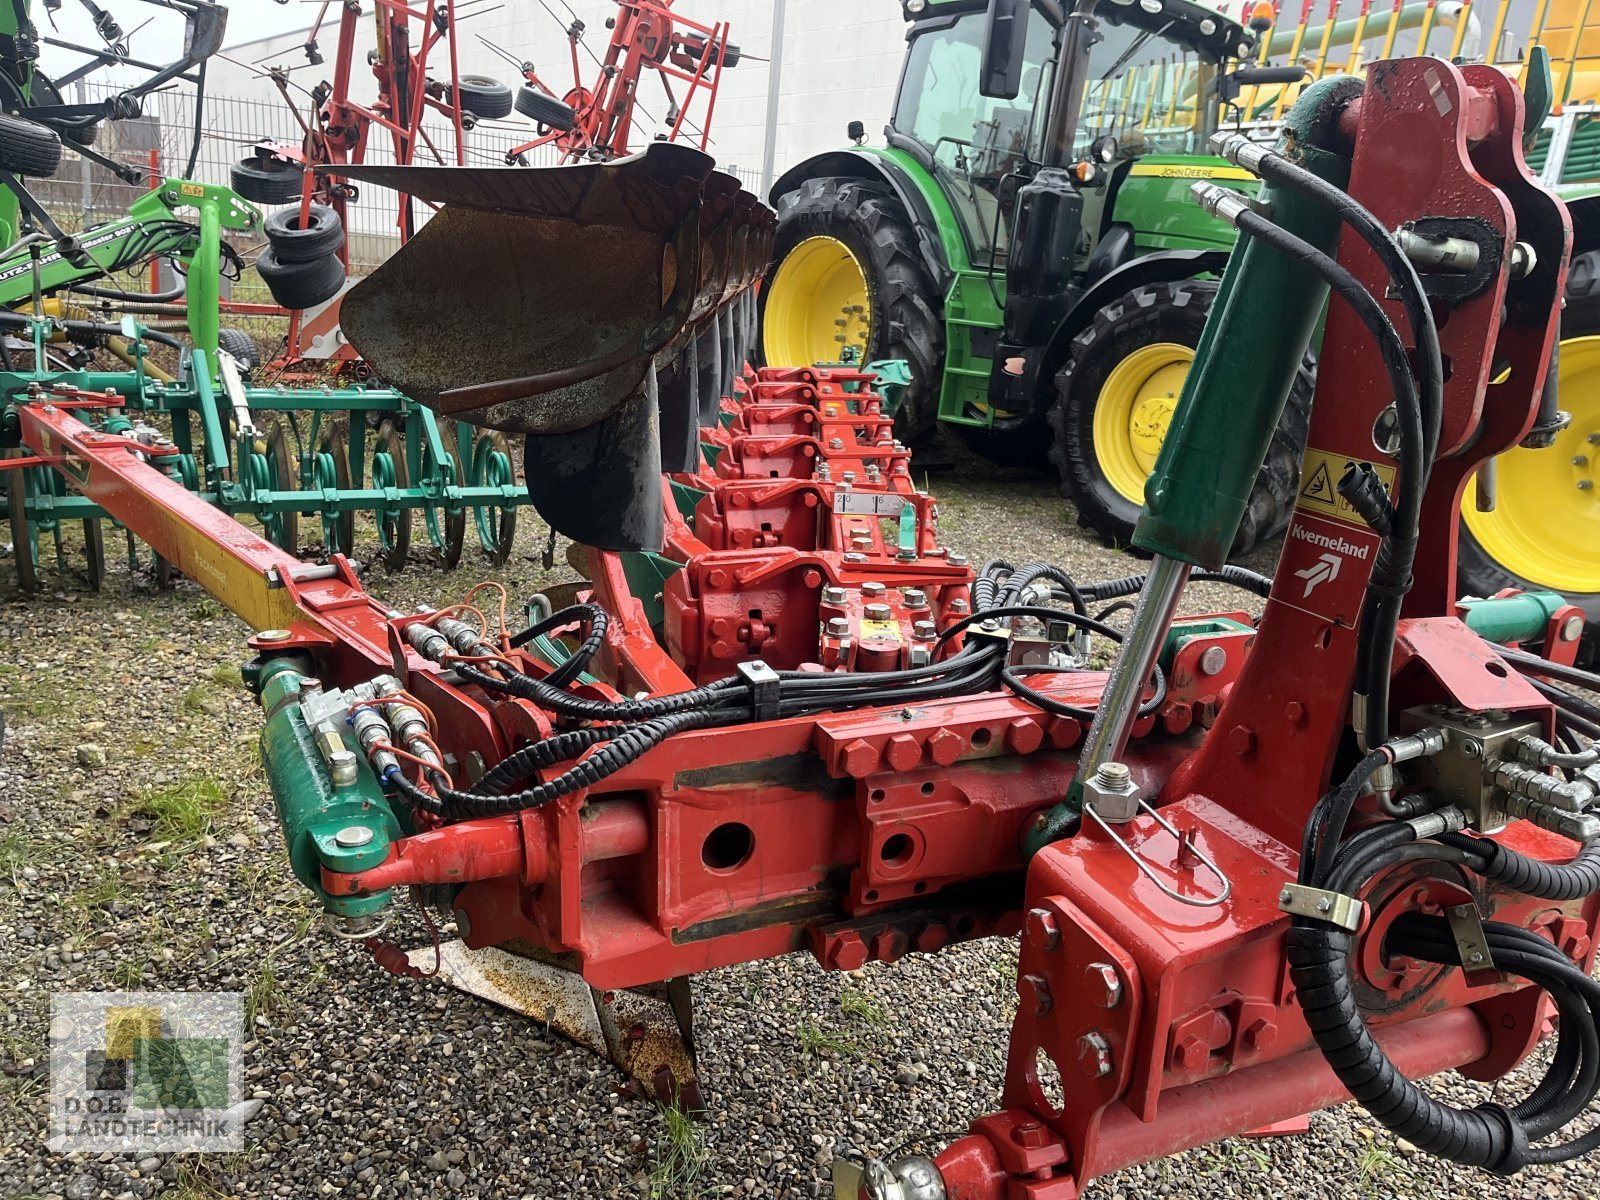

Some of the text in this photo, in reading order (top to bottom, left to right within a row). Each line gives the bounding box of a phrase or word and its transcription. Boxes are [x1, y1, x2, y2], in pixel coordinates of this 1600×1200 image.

[1160, 167, 1214, 177] JOHN DEERE
[800, 210, 832, 224] BKT
[1291, 523, 1370, 559] Kverneland
